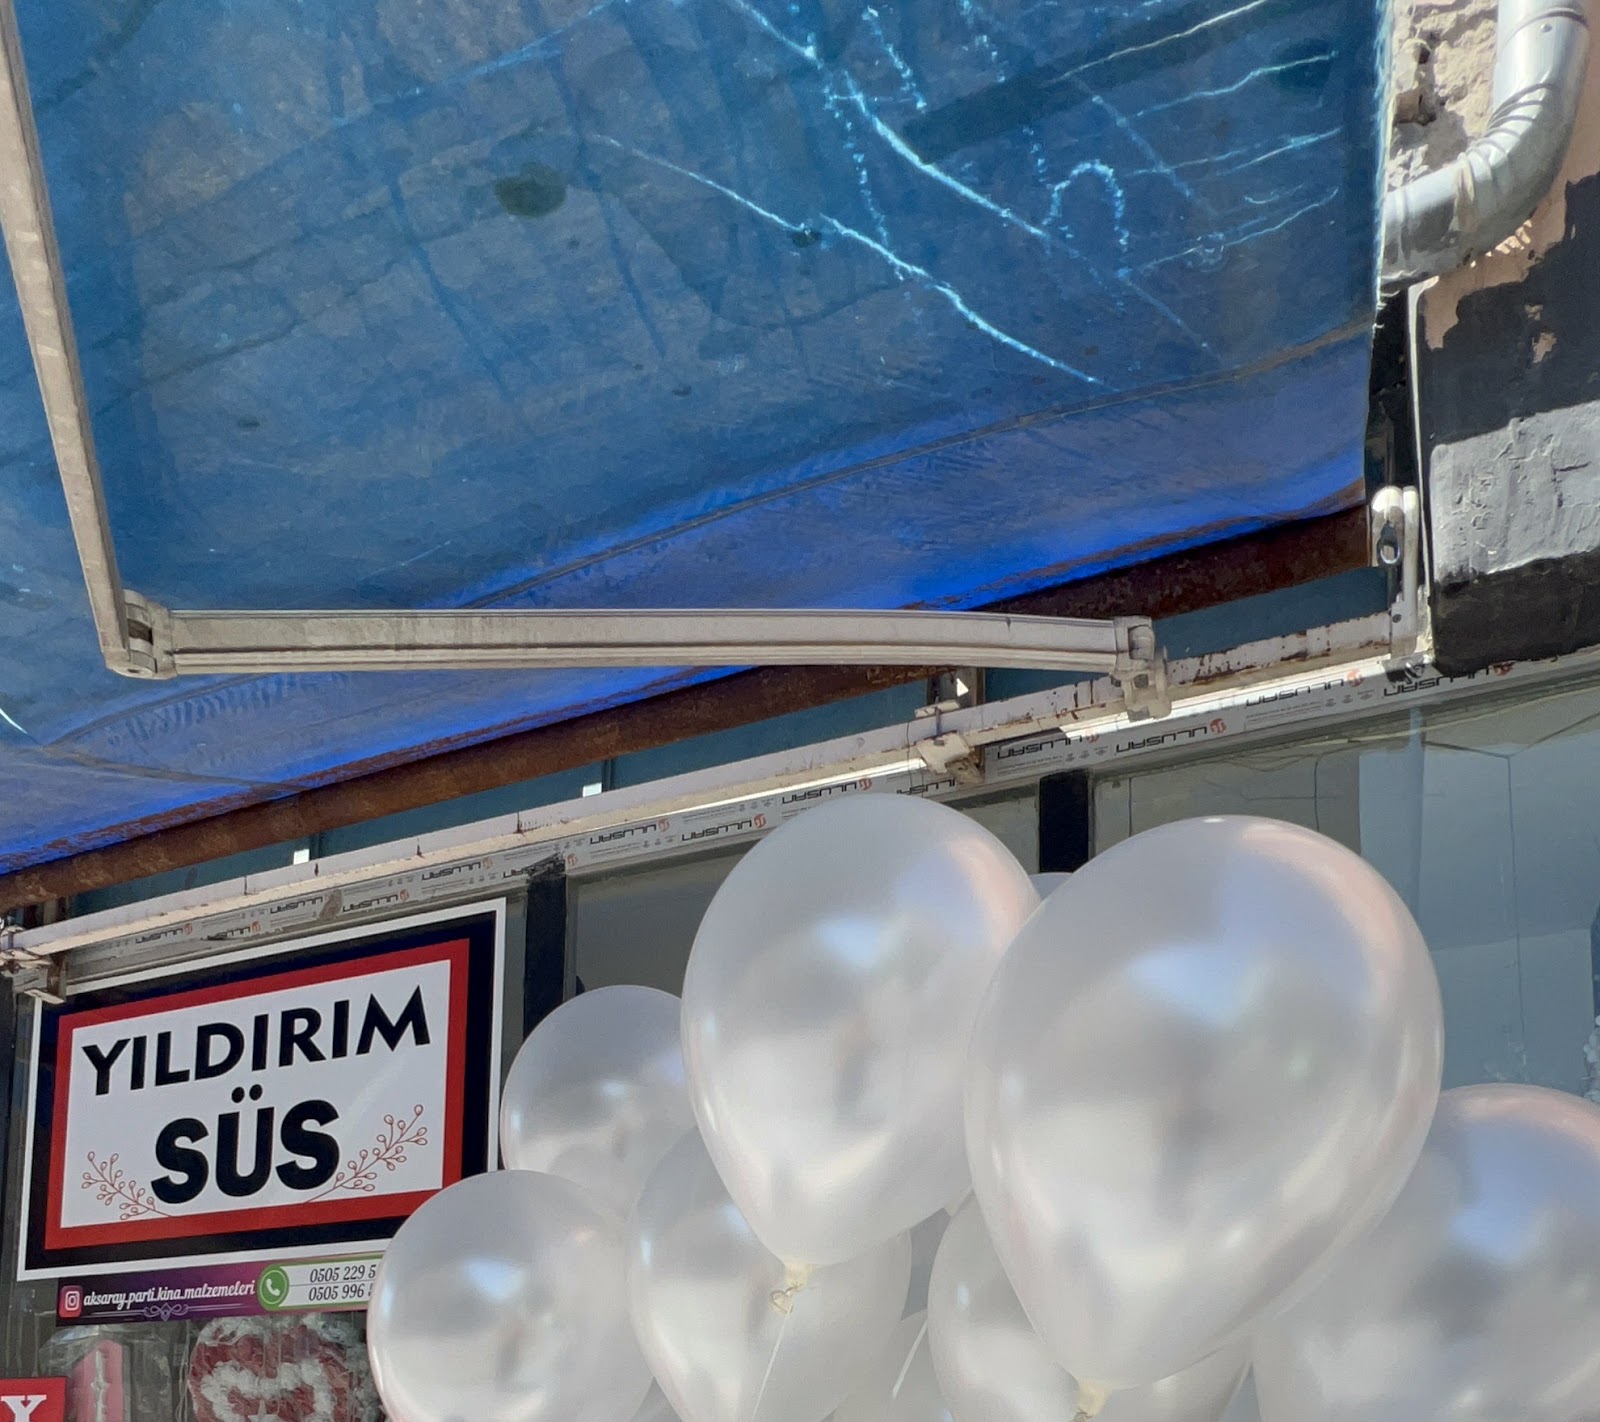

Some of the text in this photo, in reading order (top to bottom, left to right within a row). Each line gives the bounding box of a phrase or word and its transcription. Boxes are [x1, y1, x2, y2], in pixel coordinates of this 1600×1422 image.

[1245, 677, 1345, 707] ULUSAN
[1115, 725, 1208, 754] ULUSAN
[782, 780, 858, 805] ULUSAN
[589, 823, 657, 845] ULUSAN
[681, 819, 752, 842] ULUSAN
[421, 861, 482, 881] ULUSAN
[269, 895, 324, 914] ULUSAN
[342, 893, 399, 913] ULUSAN
[81, 984, 432, 1097] YILDIRIM
[150, 1083, 340, 1205] SÜS
[309, 1266, 340, 1283] 0505
[343, 1264, 366, 1281] 229
[308, 1285, 339, 1302] 0505
[341, 1282, 366, 1299] 996
